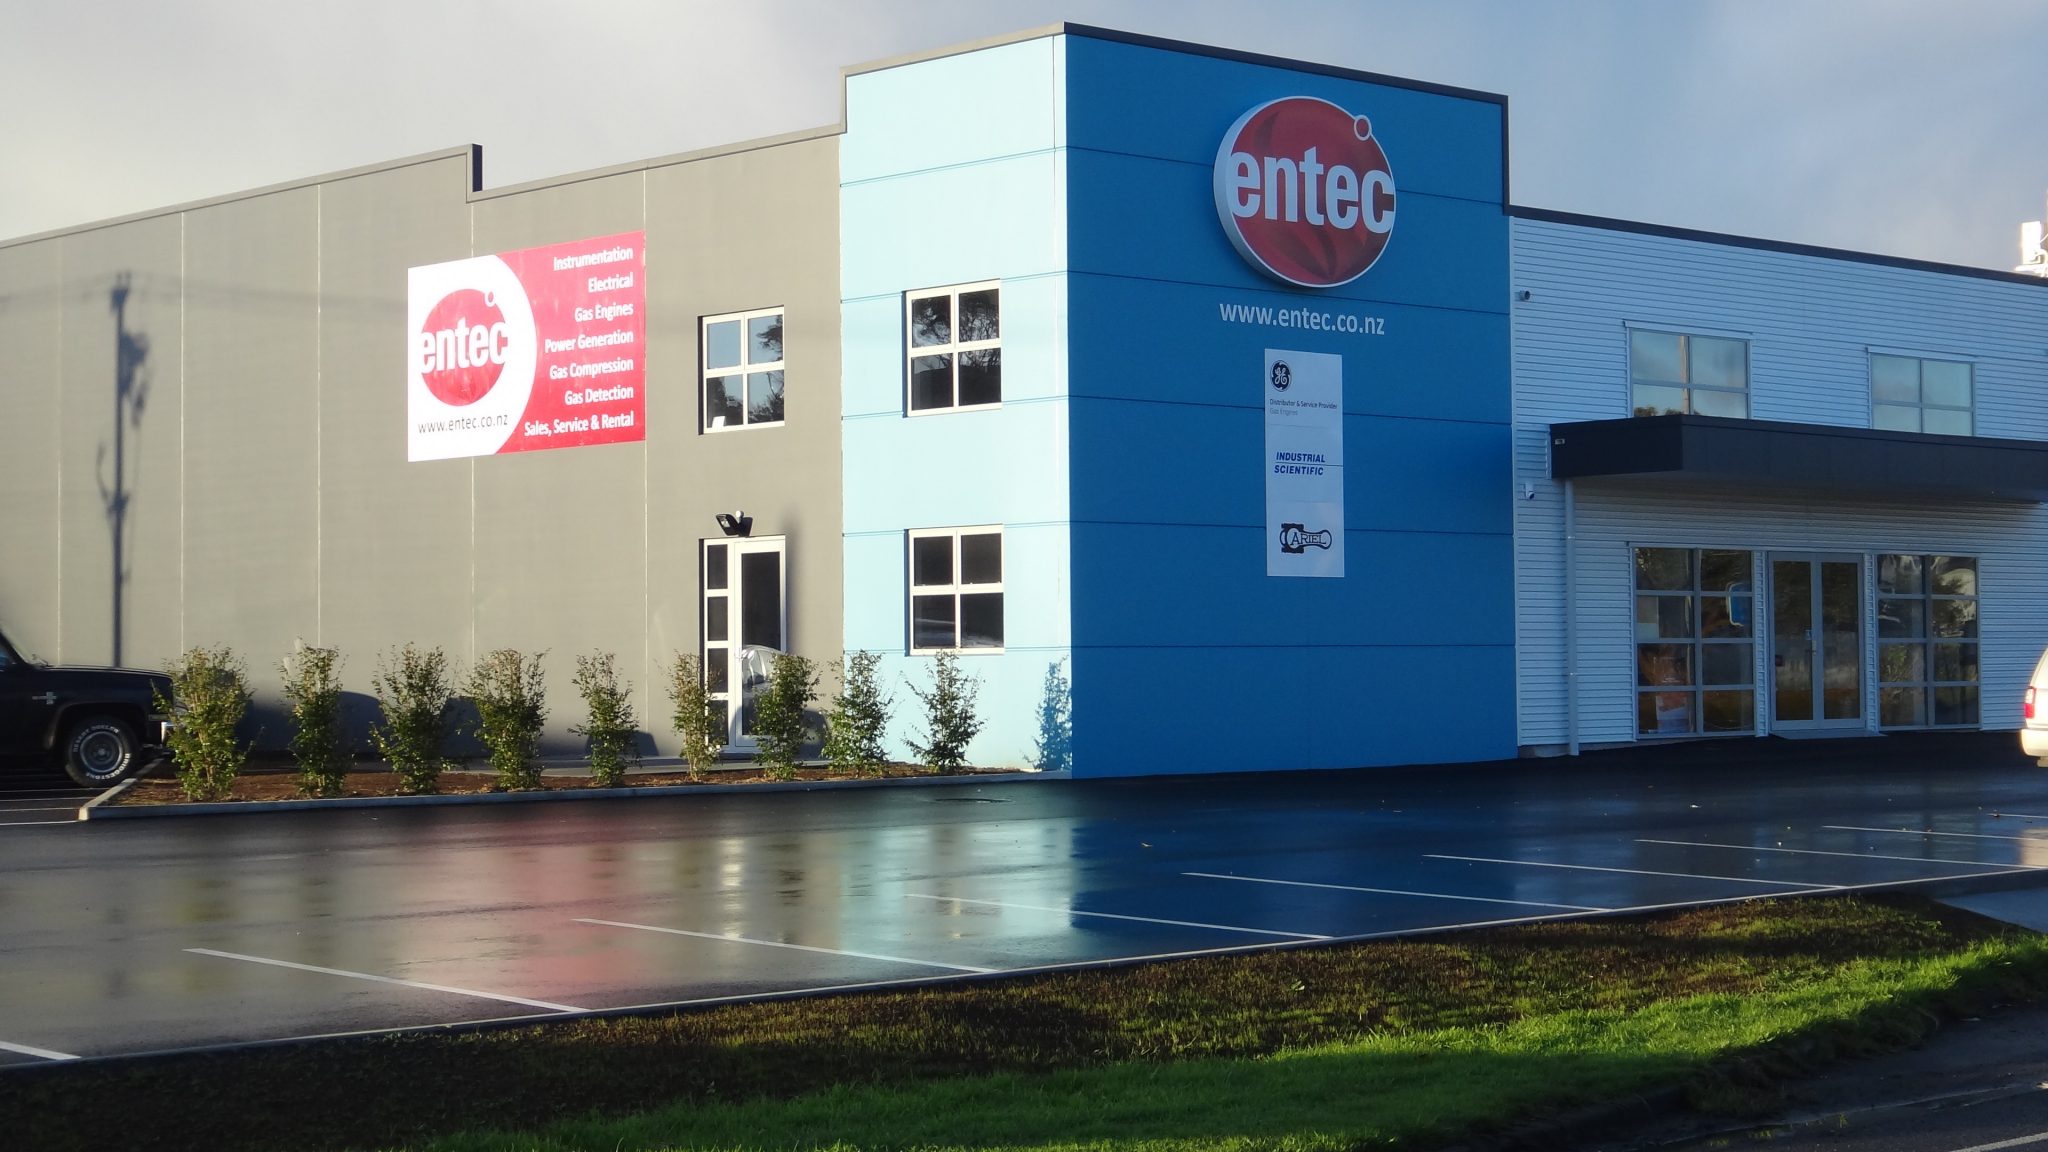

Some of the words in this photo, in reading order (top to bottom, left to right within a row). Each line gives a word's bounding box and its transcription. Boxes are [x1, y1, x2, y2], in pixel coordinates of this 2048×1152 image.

[1229, 146, 1395, 233] entec
[553, 246, 634, 271] Instrumentation
[588, 272, 634, 293] Electrical
[574, 307, 594, 322] Gas
[595, 302, 634, 321] Engines
[1219, 303, 1385, 335] www.entec.co.nz
[420, 317, 508, 374] entec
[544, 338, 576, 353] Power
[577, 330, 634, 349] Generation
[549, 365, 568, 379] Gas
[569, 356, 634, 378] Compression
[564, 390, 583, 405] Gas
[585, 384, 634, 403] Detection
[1270, 399, 1295, 407] Distributor
[418, 414, 508, 433] www.entec.co.nz
[524, 420, 552, 437] Sales,
[553, 417, 589, 433] Service
[591, 415, 600, 430] &
[602, 410, 634, 429] Rental
[1276, 452, 1326, 463] INDUSTRIAL
[1274, 465, 1324, 476] SCIENTIFIC
